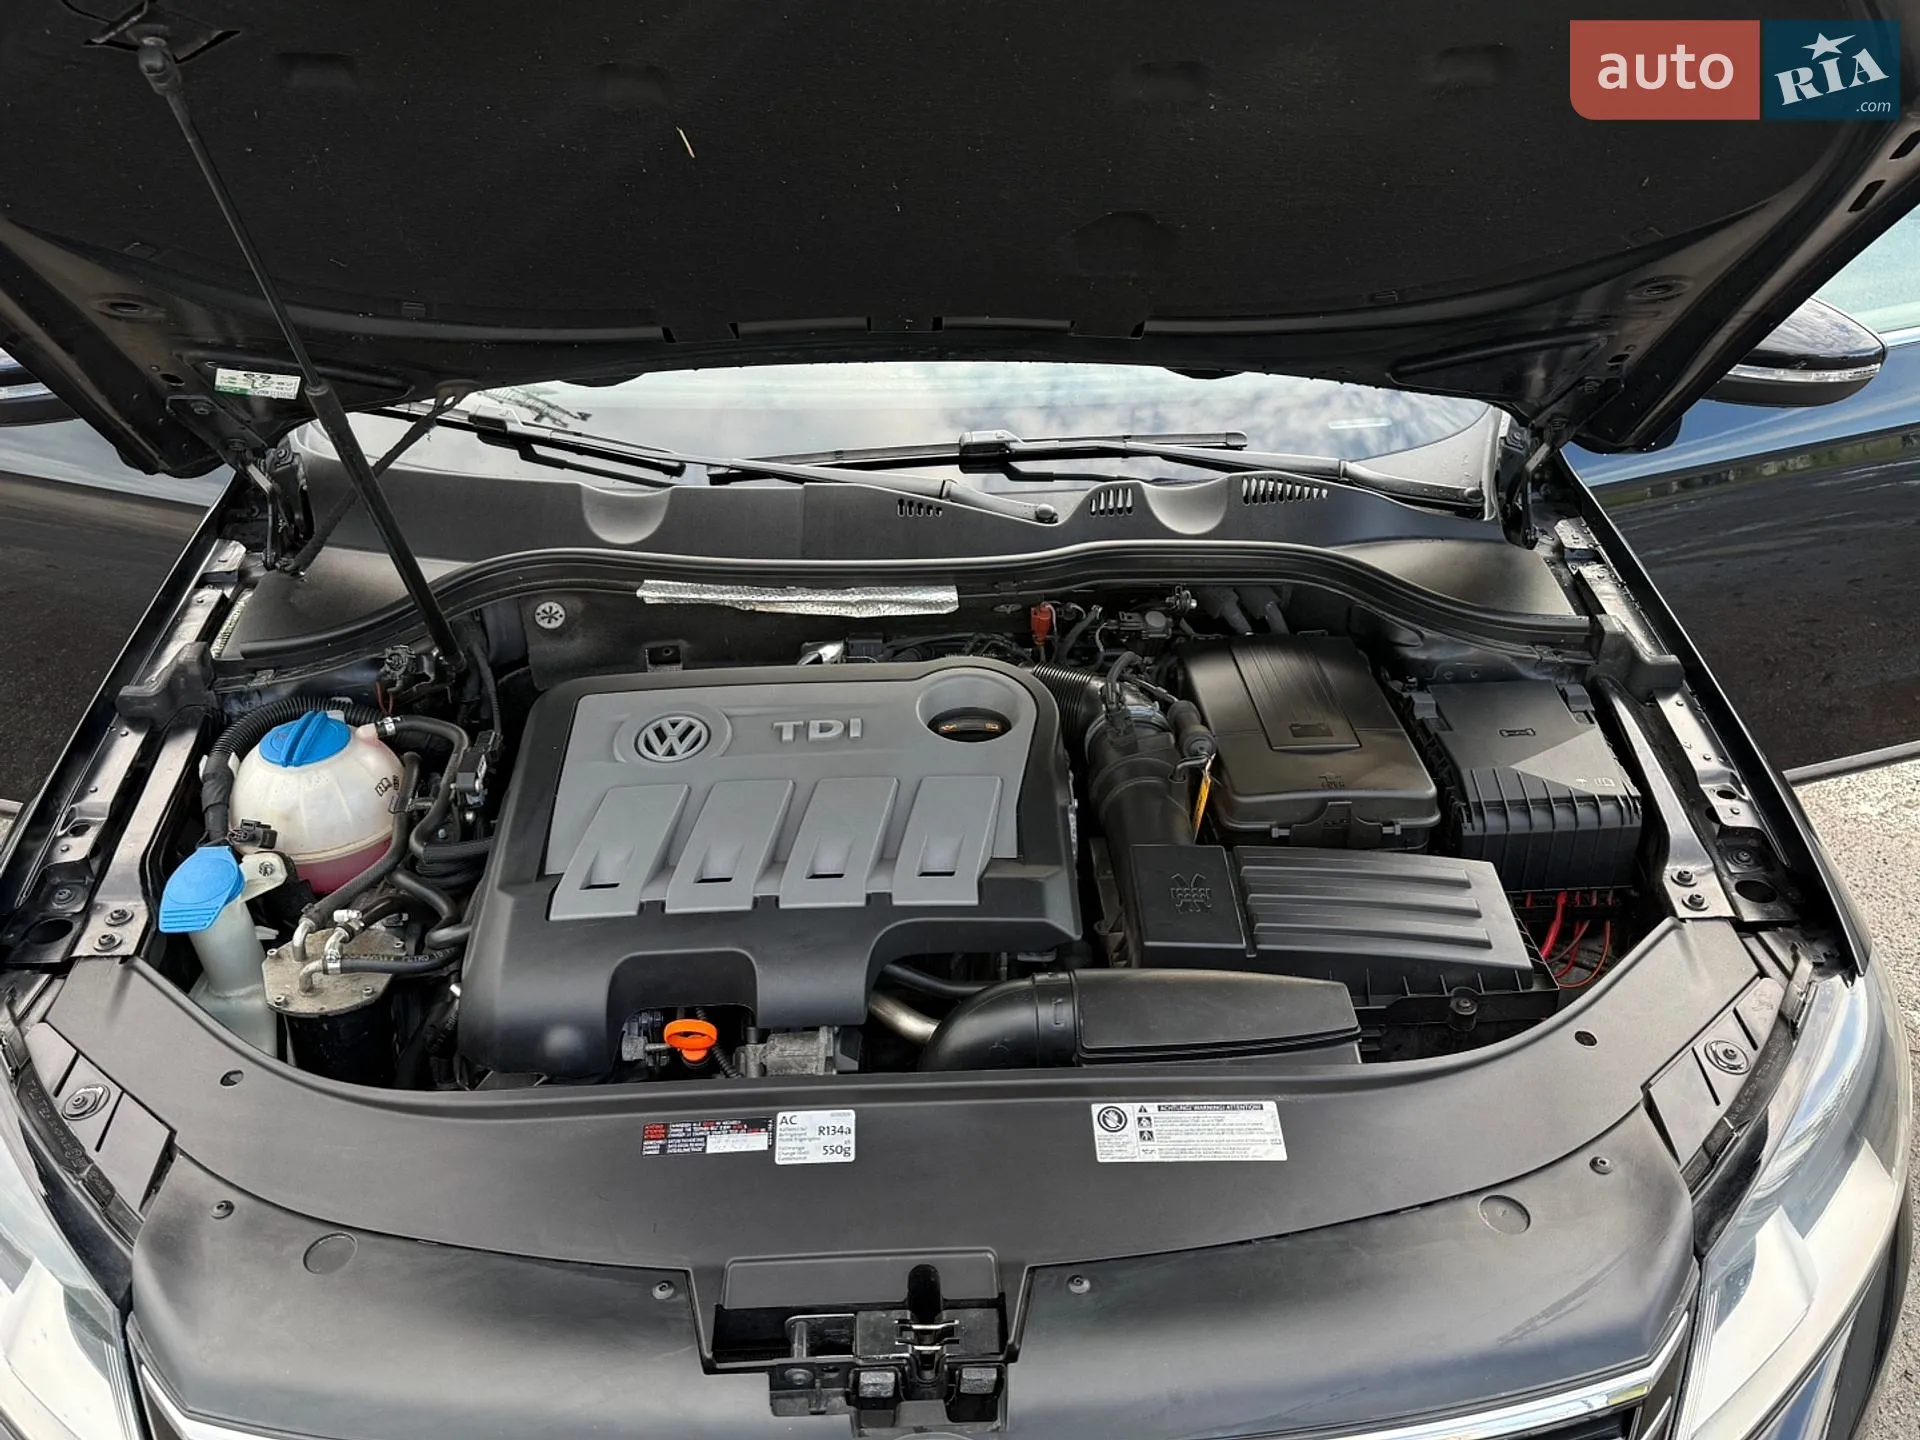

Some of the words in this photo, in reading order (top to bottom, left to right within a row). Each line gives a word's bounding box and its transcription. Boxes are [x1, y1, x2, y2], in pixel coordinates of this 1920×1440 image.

[772, 717, 862, 743] TDI
[779, 1115, 798, 1125] AC
[818, 1125, 852, 1136] R134a
[822, 1145, 851, 1157] 550g
